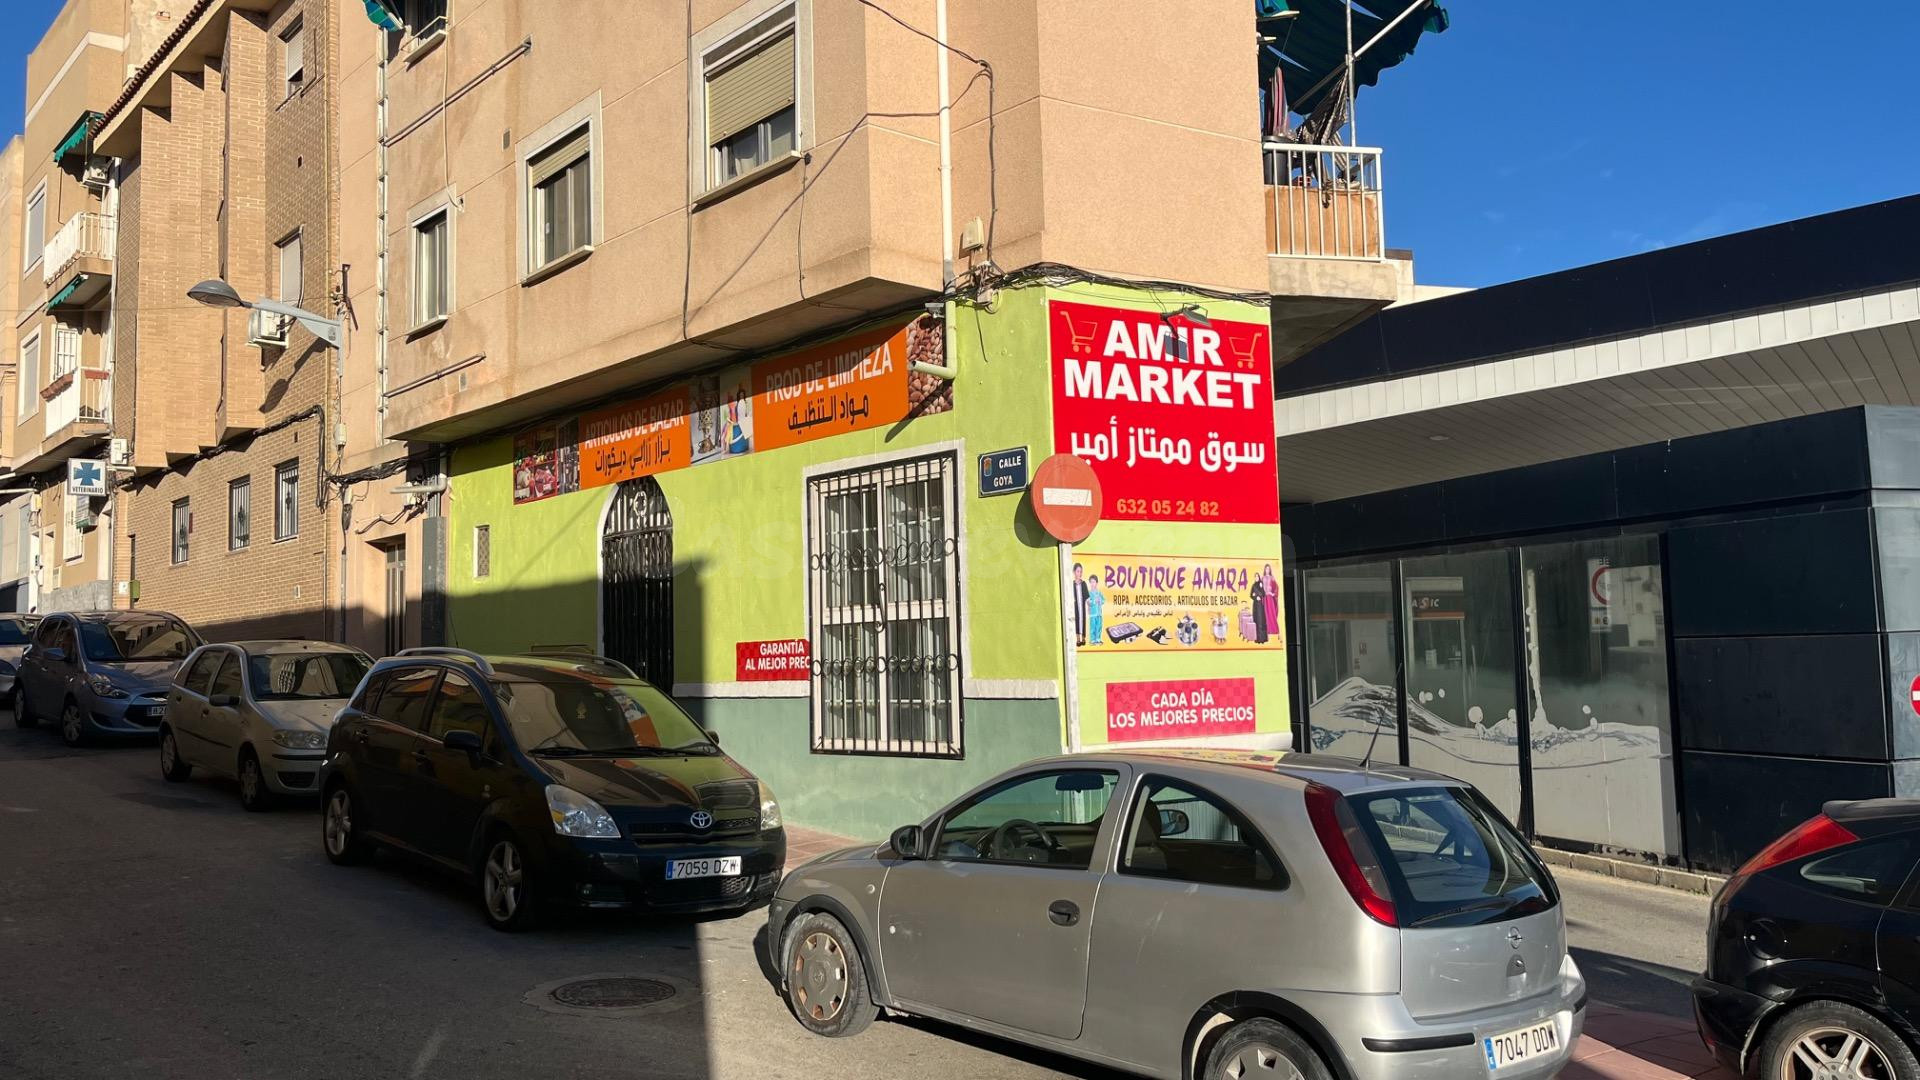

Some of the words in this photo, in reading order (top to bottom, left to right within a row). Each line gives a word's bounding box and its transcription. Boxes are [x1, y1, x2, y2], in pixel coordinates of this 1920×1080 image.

[1103, 320, 1224, 366] AMIR
[766, 368, 802, 404] PROD
[805, 360, 824, 394] DE
[828, 341, 893, 388] LIMPIEZA
[1064, 358, 1261, 409] MARKET
[585, 411, 633, 450] ARTICULOS
[634, 407, 648, 436] DE
[650, 399, 685, 433] BAZAR
[1126, 426, 1191, 468] ممتاز
[1200, 431, 1265, 472] سوق
[999, 455, 1022, 468] CALLE
[72, 486, 104, 494] VETERINARIO
[993, 475, 1013, 487] GOYA
[1116, 498, 1147, 514] 632
[1151, 499, 1172, 515] 05
[1176, 500, 1195, 515] 24
[1200, 501, 1219, 516] 82
[1104, 565, 1186, 592] BOUTIQUE
[1177, 595, 1209, 606] ARTICULOS
[1210, 595, 1218, 606] DE
[1219, 596, 1238, 606] BAZAR
[760, 639, 805, 655] GARANTÍA
[745, 658, 756, 671] AL
[758, 657, 787, 670] MEJOR
[1151, 692, 1188, 708] CADA
[1191, 688, 1215, 707] DÍA
[1109, 711, 1136, 728] LOS
[1140, 709, 1198, 727] MEJORES
[1202, 706, 1254, 723] PRECIOS
[677, 861, 709, 877] 7059
[713, 859, 737, 874] DZW
[1495, 1032, 1528, 1064] 7047
[1532, 1024, 1556, 1053] DDW
